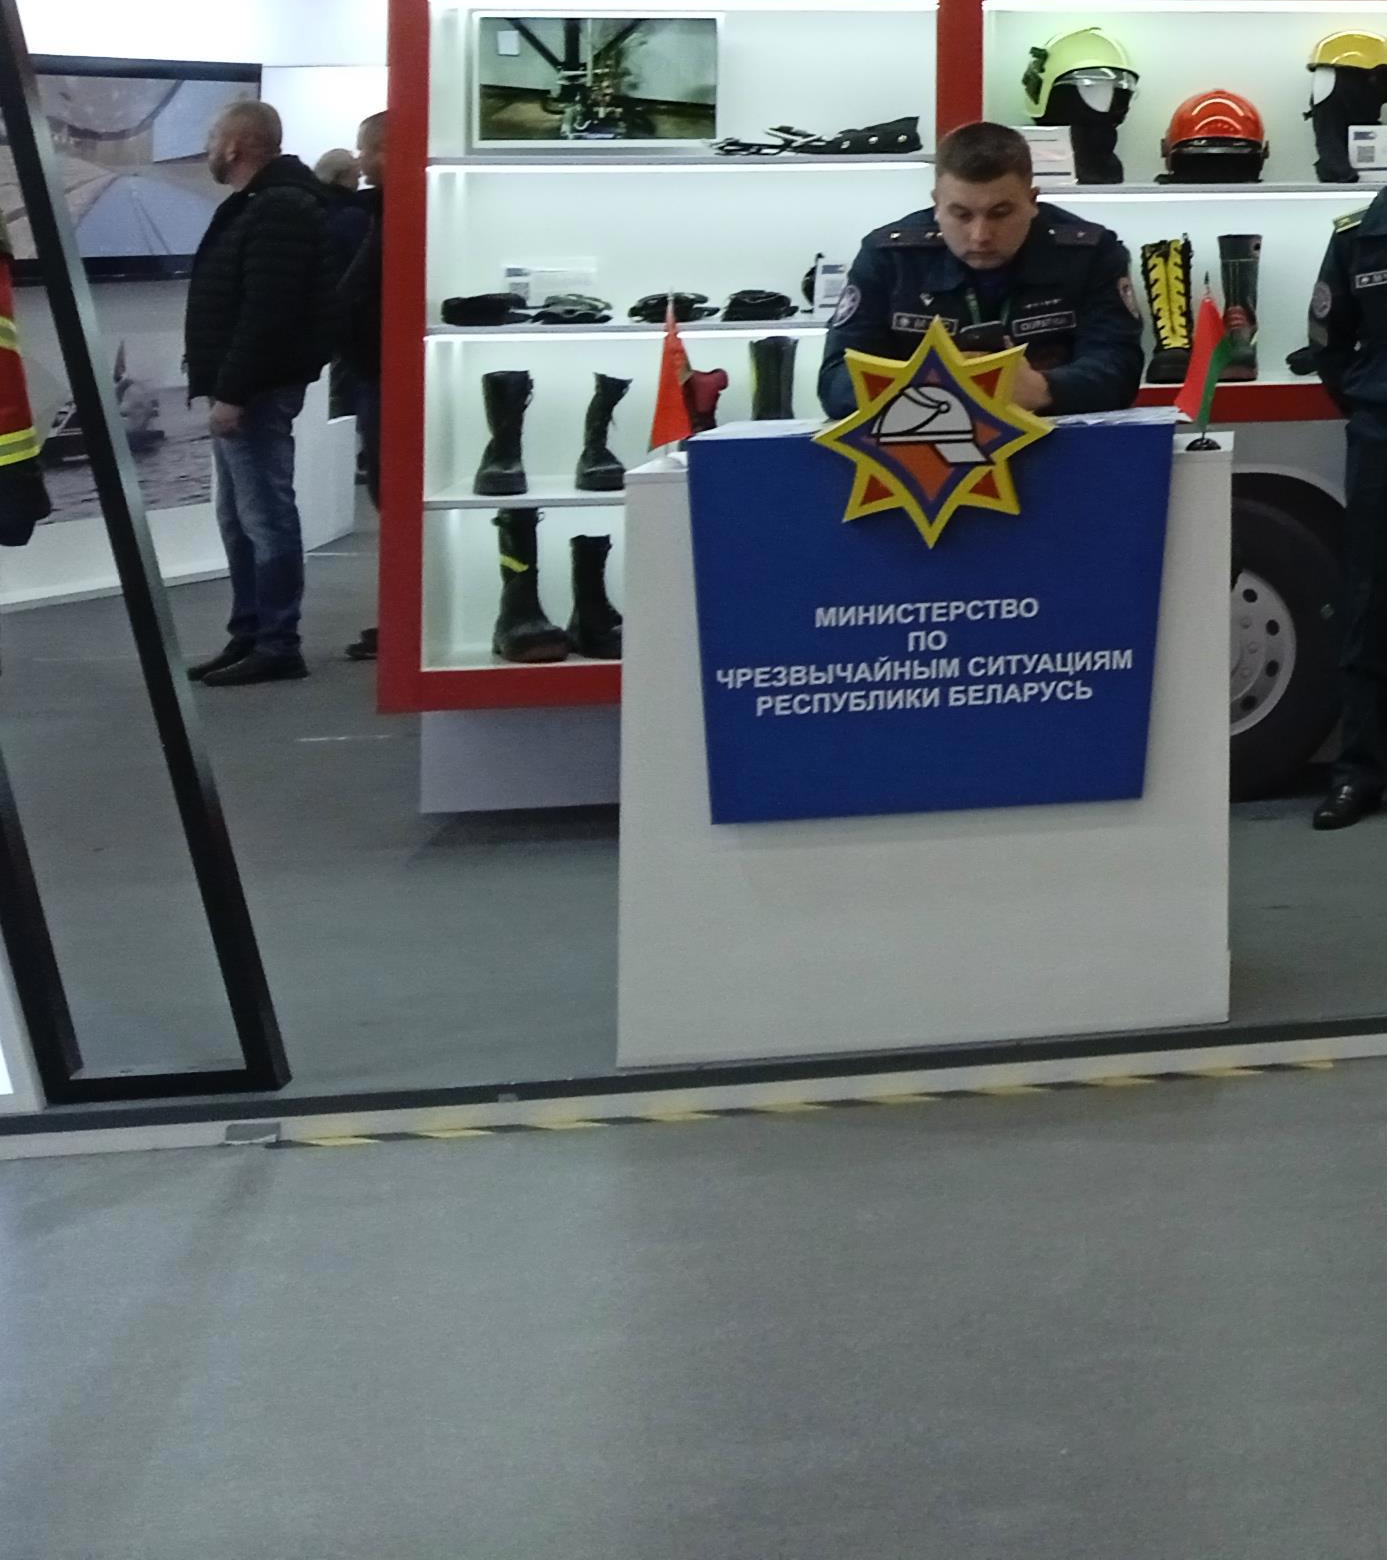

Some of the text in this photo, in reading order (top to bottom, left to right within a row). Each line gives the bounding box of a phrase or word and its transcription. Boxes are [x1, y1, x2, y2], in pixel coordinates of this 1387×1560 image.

[815, 597, 1039, 628] МИНИСТЕРСТВО
[907, 631, 947, 652] ПО
[717, 649, 1132, 689] ЧРЕЗВЫЧАЙНЫМ СИТУАЦИЯМ
[757, 680, 1093, 717] РЕСПУБЛИКИ БЕЛАРУСЬ
